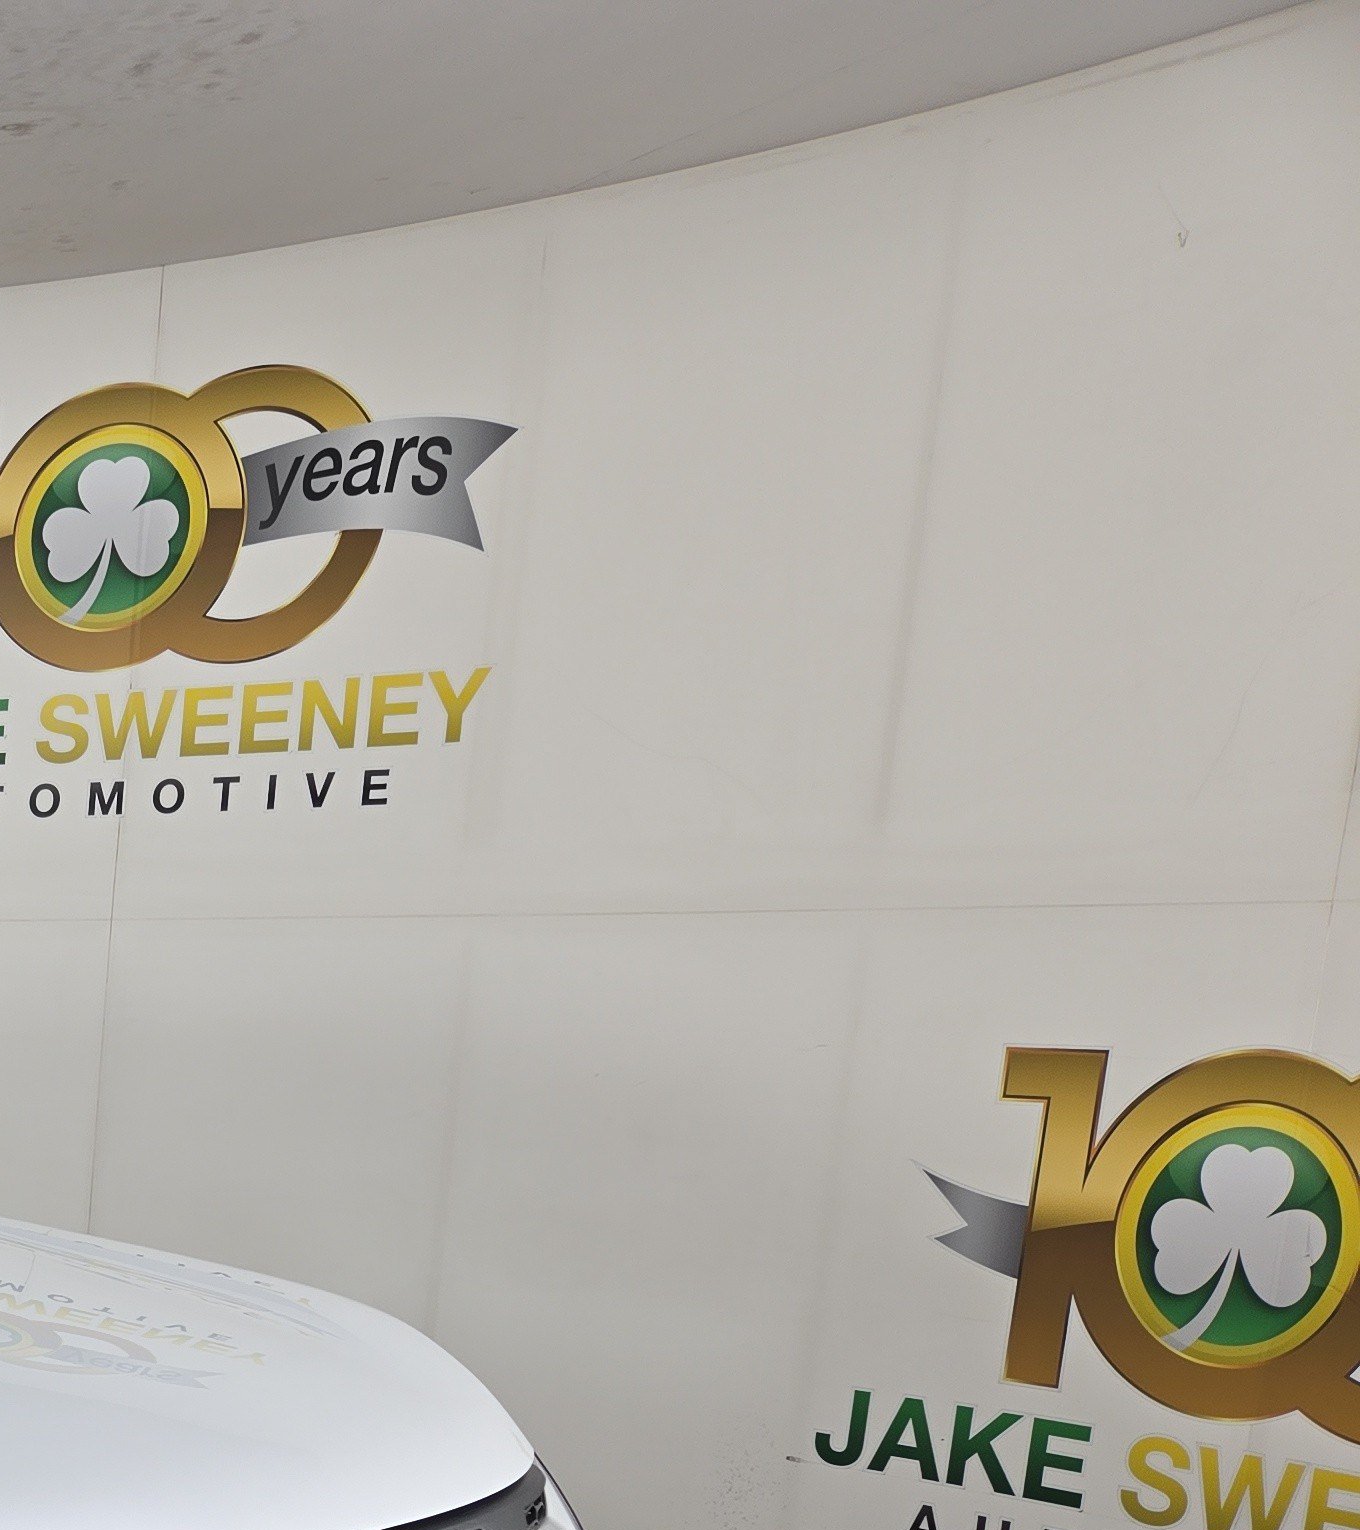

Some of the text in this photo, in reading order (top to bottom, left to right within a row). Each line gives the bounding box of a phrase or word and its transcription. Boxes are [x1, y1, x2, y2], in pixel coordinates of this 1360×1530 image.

[258, 435, 453, 530] years
[35, 667, 492, 765] SWEENEY
[814, 1389, 1093, 1510] JAKE
